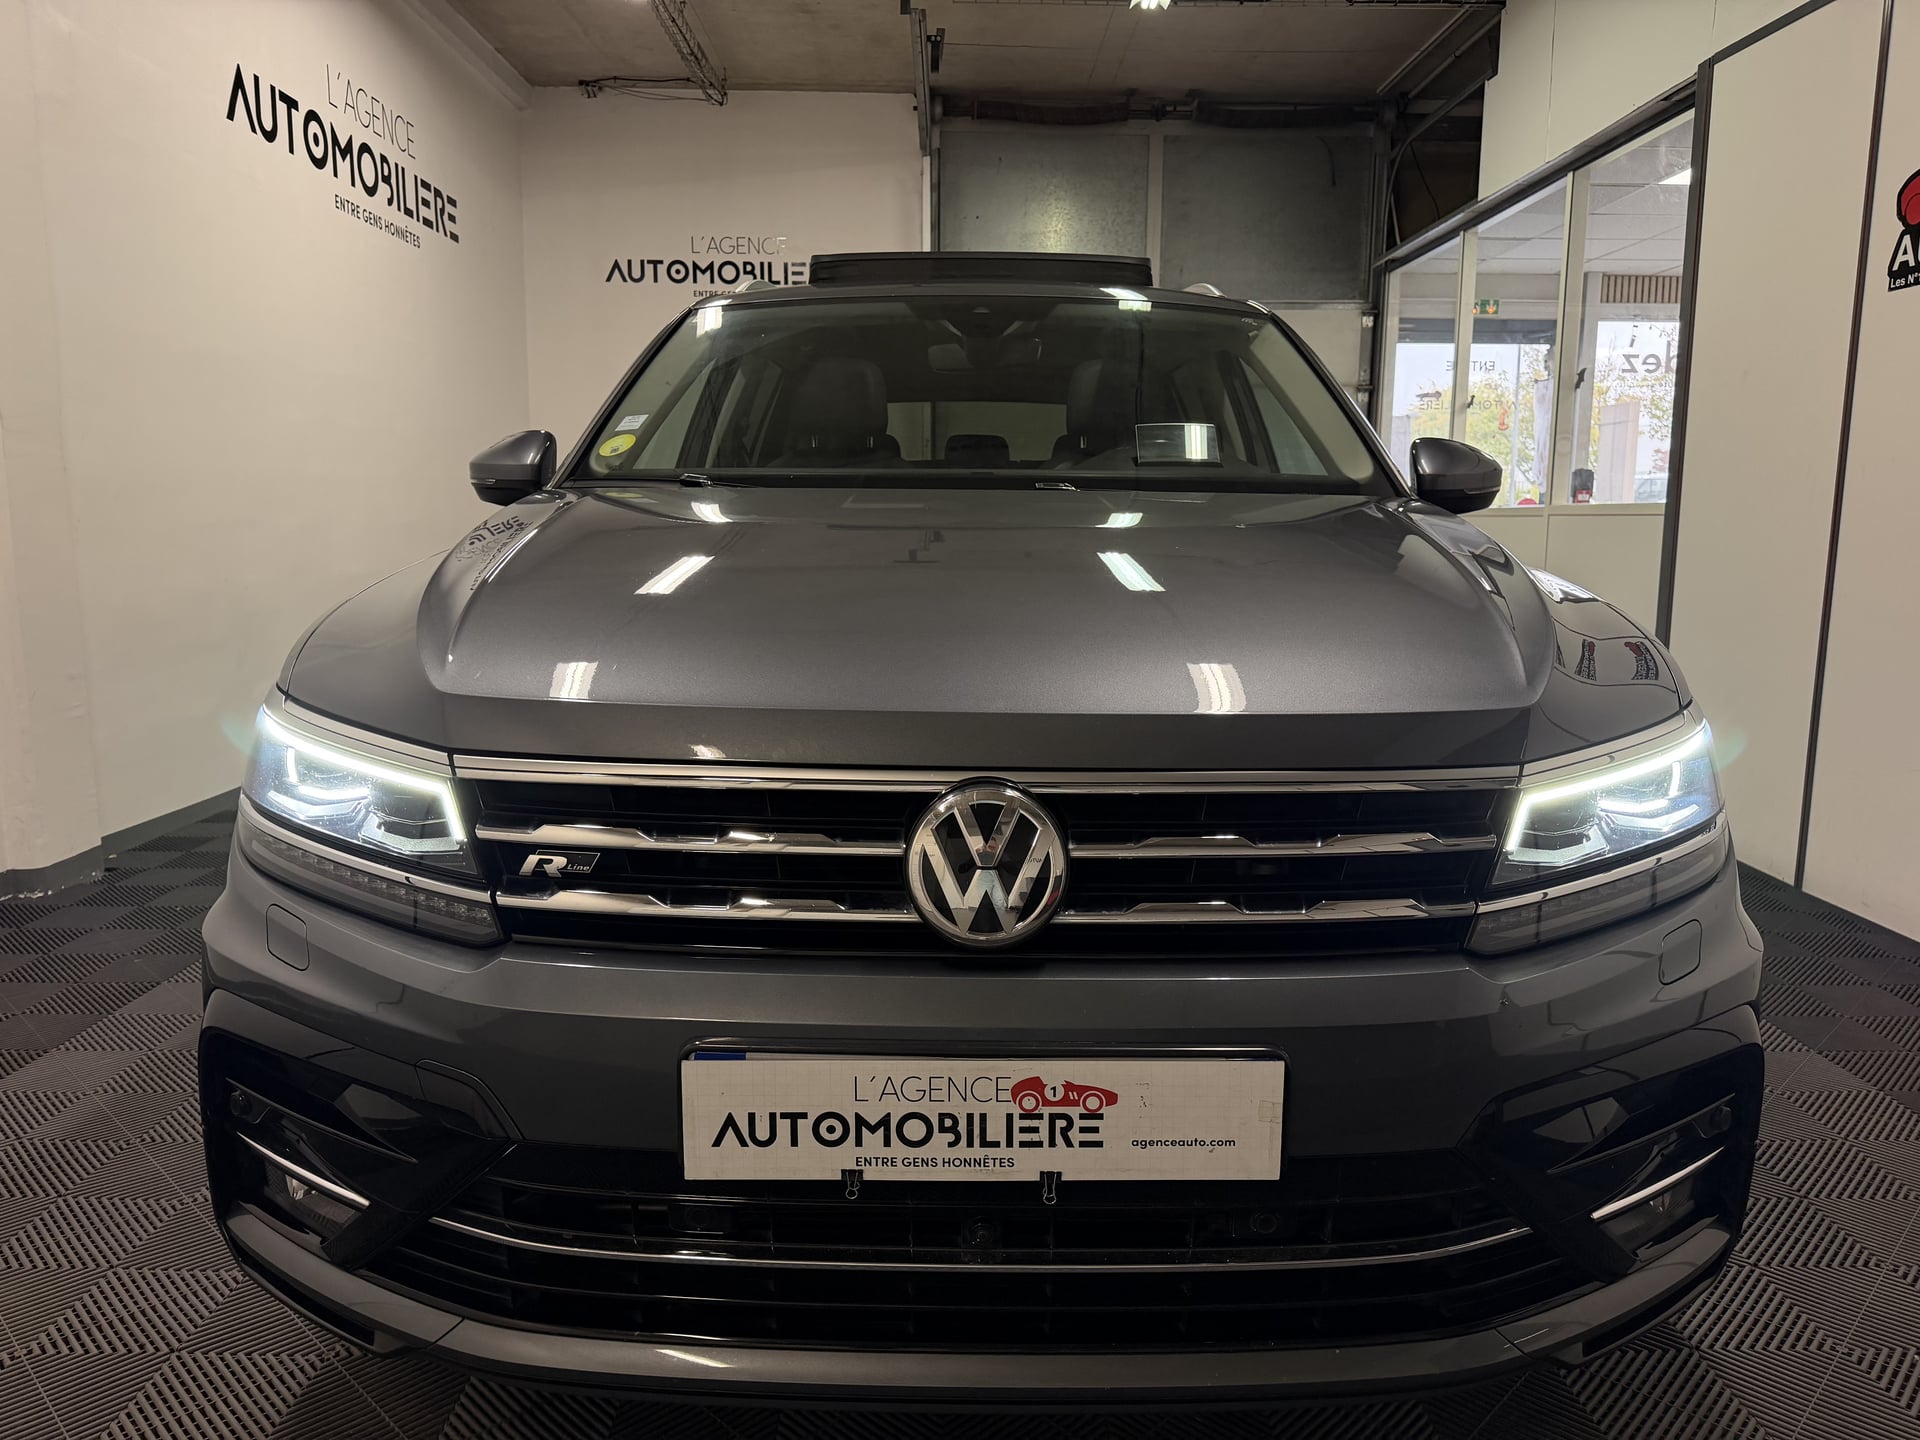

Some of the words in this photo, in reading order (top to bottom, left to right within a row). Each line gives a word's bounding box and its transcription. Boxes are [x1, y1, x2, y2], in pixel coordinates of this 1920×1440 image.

[326, 63, 416, 160] L'AGENCE
[226, 63, 460, 244] AUTOMOBILIERE
[334, 193, 361, 220] ENTRE
[362, 208, 383, 231] GENS
[384, 218, 421, 249] HONNÊTES
[605, 258, 807, 285] AUTOMOBILIE
[1890, 277, 1906, 288] Les
[519, 854, 568, 878] R
[567, 863, 590, 872] Line
[854, 1075, 1013, 1103] L'AGENCE
[1049, 1085, 1058, 1098] 1
[711, 1111, 1105, 1149] AUTOMOBILIERE
[1131, 1137, 1236, 1150] agenceauto.com
[855, 1156, 898, 1168] ENTRE
[901, 1156, 938, 1168] GENS
[942, 1154, 1015, 1168] HONNÊTES
